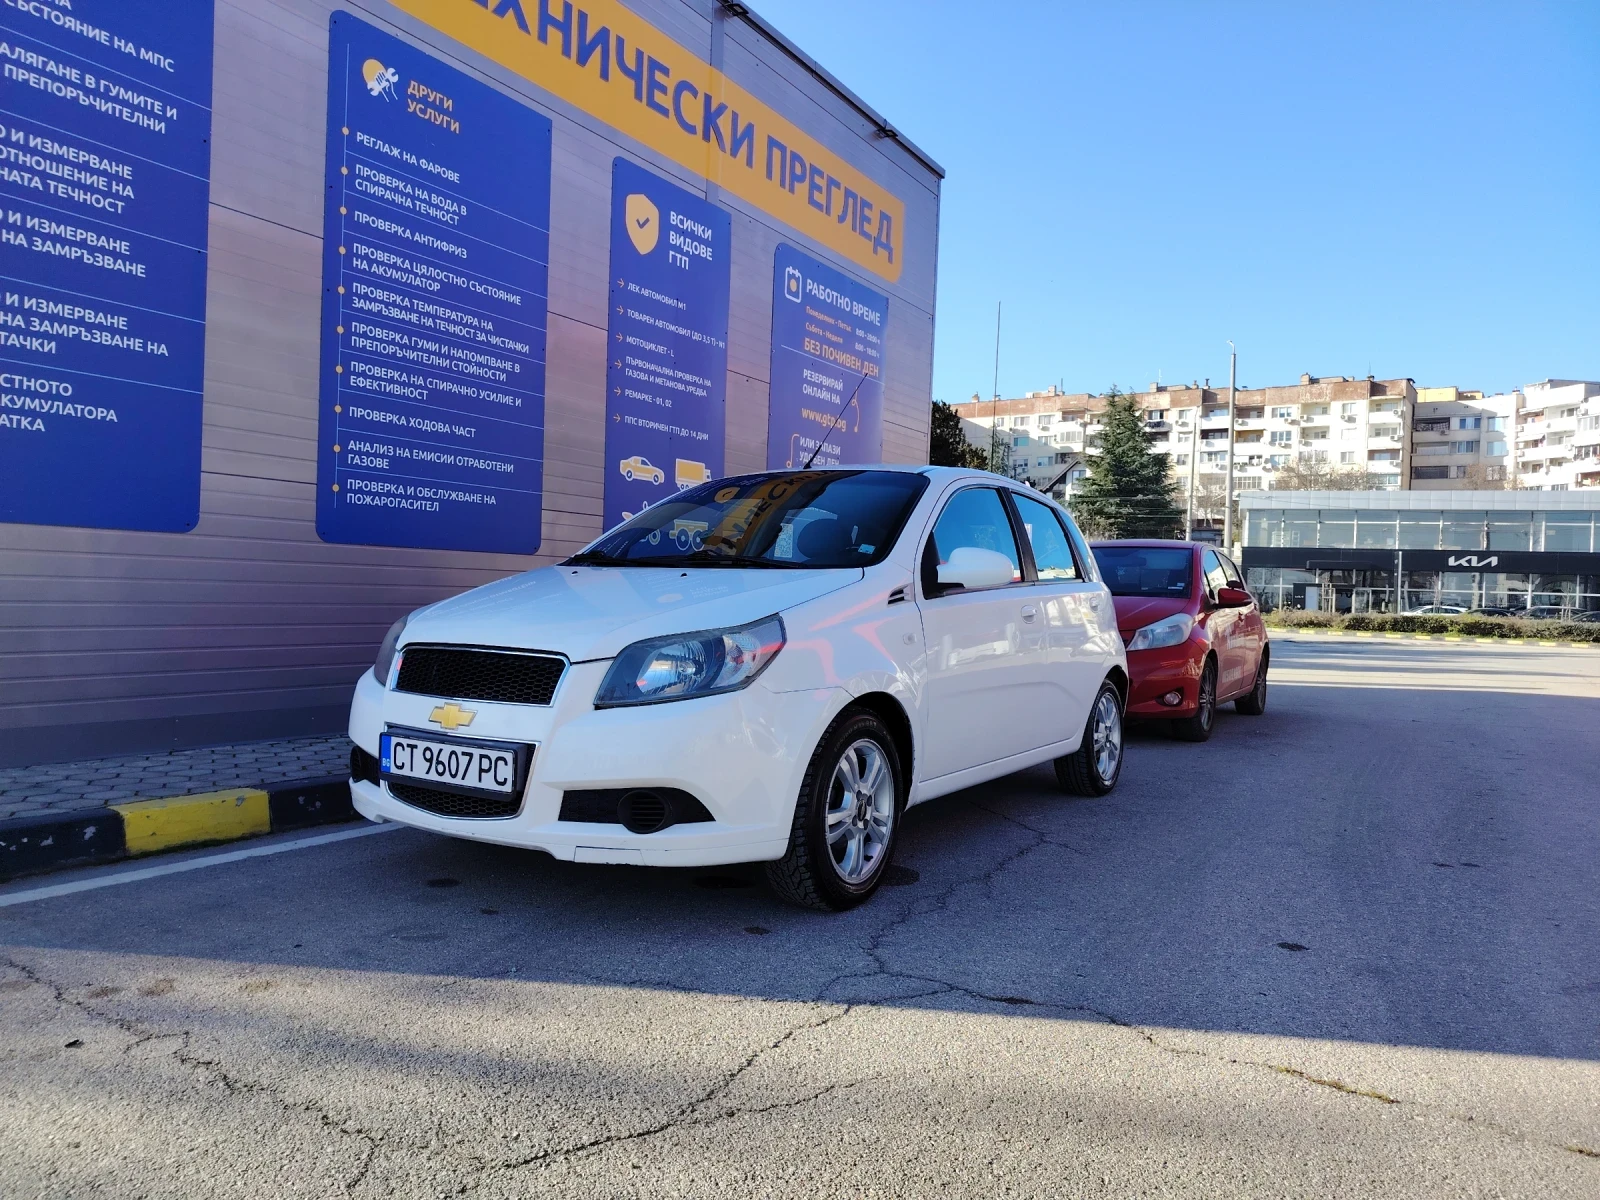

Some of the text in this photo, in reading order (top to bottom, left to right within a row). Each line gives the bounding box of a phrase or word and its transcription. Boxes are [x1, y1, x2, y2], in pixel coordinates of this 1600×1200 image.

[114, 36, 137, 57] НА
[139, 46, 175, 73] МПС
[0, 42, 178, 120] АЛЯГАНЕ В ГУМИТЕ И
[408, 80, 453, 112] ДРУГИ
[4, 63, 166, 135] ПРЕПОРЪЧИТЕЛНИ
[407, 99, 460, 134] УСЛУГИ
[470, 0, 894, 263] ХНИЧЕСКИ ПРЕГЛЕД
[11, 128, 24, 144] И
[29, 134, 133, 179] ИЗМЕРВАНЕ
[356, 132, 460, 183] РЕГЛАЖ НА ФАРОВЕ
[47, 180, 125, 215] ТЕЧНОСТ
[113, 181, 135, 199] НА
[355, 164, 467, 216] ПРОВЕРКА НА ВОДА В
[355, 179, 459, 225] СПИРАЧНА ТЕЧНОСТ
[8, 210, 130, 255] И ИЗМЕРВАНЕ
[354, 211, 467, 259] ПРОВЕРКА АНТИФРИЗ
[670, 211, 712, 241] ВСИЧКИ
[2, 229, 146, 277] НА ЗАМРЪЗВАНЕ
[668, 250, 689, 270] ГТП
[669, 231, 713, 261] ВИДОВЕ
[353, 243, 521, 306] ПРОВЕРКА ЦЯЛОСТНО СЪСТОЯНИЕ
[353, 257, 441, 292] НА АКУМУЛАТОР
[5, 292, 128, 330] И ИЗМЕРВАНЕ
[353, 283, 493, 332] ПРОВЕРКА ТЕМПЕРАТУРА НА
[627, 282, 640, 294] ЛЕК
[640, 288, 677, 307] АВТОМОБИЛ
[806, 279, 880, 326] РАБОТНО ВРЕМЕ
[0, 311, 169, 357] НА ЗАМРЪЗВАНЕ НА
[352, 297, 529, 354] ЗАМРЪЗВАНЕ НА ТЕЧНОСТ ЗА ЧИСТАЧКИ
[627, 309, 654, 325] ТОВАРЕН
[655, 320, 691, 338] АВТОМОБИЛ
[0, 331, 56, 354] ТАЧКИ
[352, 322, 520, 373] ПРОВЕРКА ГУМИ И НАПОМПВАНЕ В
[626, 335, 667, 355] МОТОЦИКЛЕТ
[804, 337, 879, 377] БЕЗ ПОЧИВЕН ДЕН
[351, 337, 506, 382] ПРЕПОРЪЧИТЕЛНИ СТОЙНОСТИ
[625, 356, 712, 388] ПЪРВОНАЧАЛНА ПРОВЕРКА НА
[0, 373, 72, 396] СТНОТО
[350, 361, 522, 407] ПРОВЕРКА НА СПИРАЧНО УСИЛИЕ И
[350, 375, 428, 400] ЕФЕКТИВНОСТ
[624, 389, 653, 403] РЕМАРКЕ
[625, 368, 649, 381] ГАЗОВА
[655, 377, 686, 392] МЕТАНОВА
[686, 385, 708, 397] УРЕДБА
[802, 383, 841, 405] ОНЛАЙН НА
[803, 368, 843, 391] РЕЗЕРВИРАЙ
[0, 393, 118, 422] КУМУЛАТОРА
[0, 413, 45, 432] АТКА
[349, 407, 476, 438] ПРОВЕРКА ХОДОВА ЧАСТ
[801, 407, 847, 432] www.gtp.bg
[624, 415, 709, 441] ППС ВТОРИЧЕН ГТП ДО 14 ДНИ
[800, 436, 815, 449] ИЛИ
[348, 440, 514, 473] АНАЛИЗ НА ЕМИСИИ ОТРАБОТЕНИ
[348, 454, 389, 469] ГАЗОВЕ
[346, 493, 439, 511] ПОЖАРОГАСИТЕЛ
[347, 479, 496, 505] ПРОВЕРКА И ОБСЛУЖВАНЕ НА
[393, 742, 509, 786] CT 9607 PC
